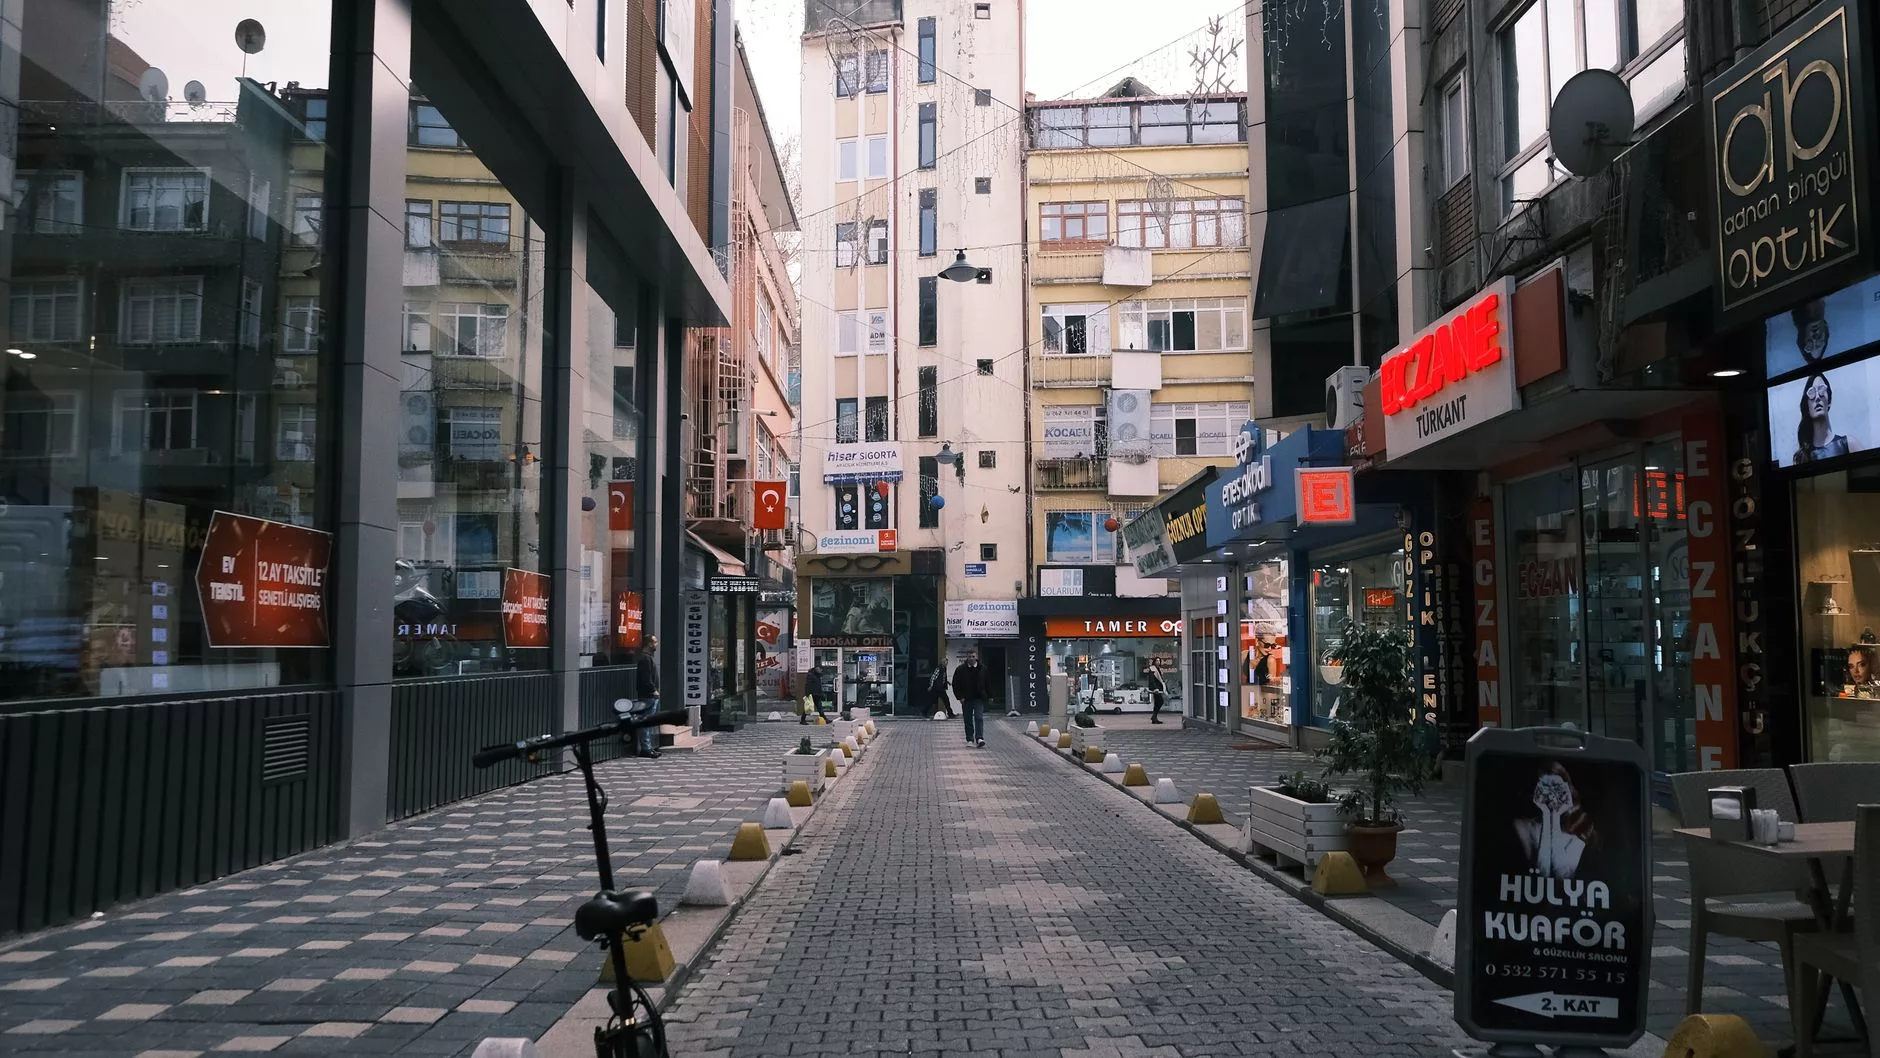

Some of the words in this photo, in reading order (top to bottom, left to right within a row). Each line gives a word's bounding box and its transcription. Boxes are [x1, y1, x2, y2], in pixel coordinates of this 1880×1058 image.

[1724, 192, 1780, 236] adnan
[1728, 203, 1849, 289] optik
[1380, 293, 1502, 416] ECZANE
[1416, 394, 1467, 439] TÜRKANT
[828, 451, 858, 462] hisar
[1222, 477, 1242, 508] enes
[820, 534, 876, 548] gezinomi
[1166, 511, 1196, 545] GÖZNUR
[222, 555, 236, 574] EV
[258, 561, 269, 581] 12
[269, 562, 283, 582] AY
[282, 562, 321, 587] TAKSİTLE
[1041, 586, 1082, 596] SOLARIUM
[1419, 531, 1436, 627] OPTİK
[967, 601, 1017, 612] gezinomi
[966, 619, 988, 627] hisar
[1084, 620, 1148, 632] TAMER
[1028, 636, 1037, 708] GÖZLÜKÇÜ
[1422, 655, 1438, 726] LENS
[1500, 867, 1610, 910] HÜLYA
[1484, 909, 1626, 950] KUAFÖR
[1533, 947, 1541, 957] &
[1542, 946, 1586, 961] GÜZELLİK
[1587, 951, 1628, 964] SALONU
[1485, 963, 1497, 976] 0
[1502, 964, 1532, 978] 532
[1537, 966, 1568, 980] 571
[1575, 969, 1597, 982] 55
[1606, 971, 1626, 984] 15
[1541, 998, 1557, 1012] 2.
[1563, 998, 1601, 1013] KAT
